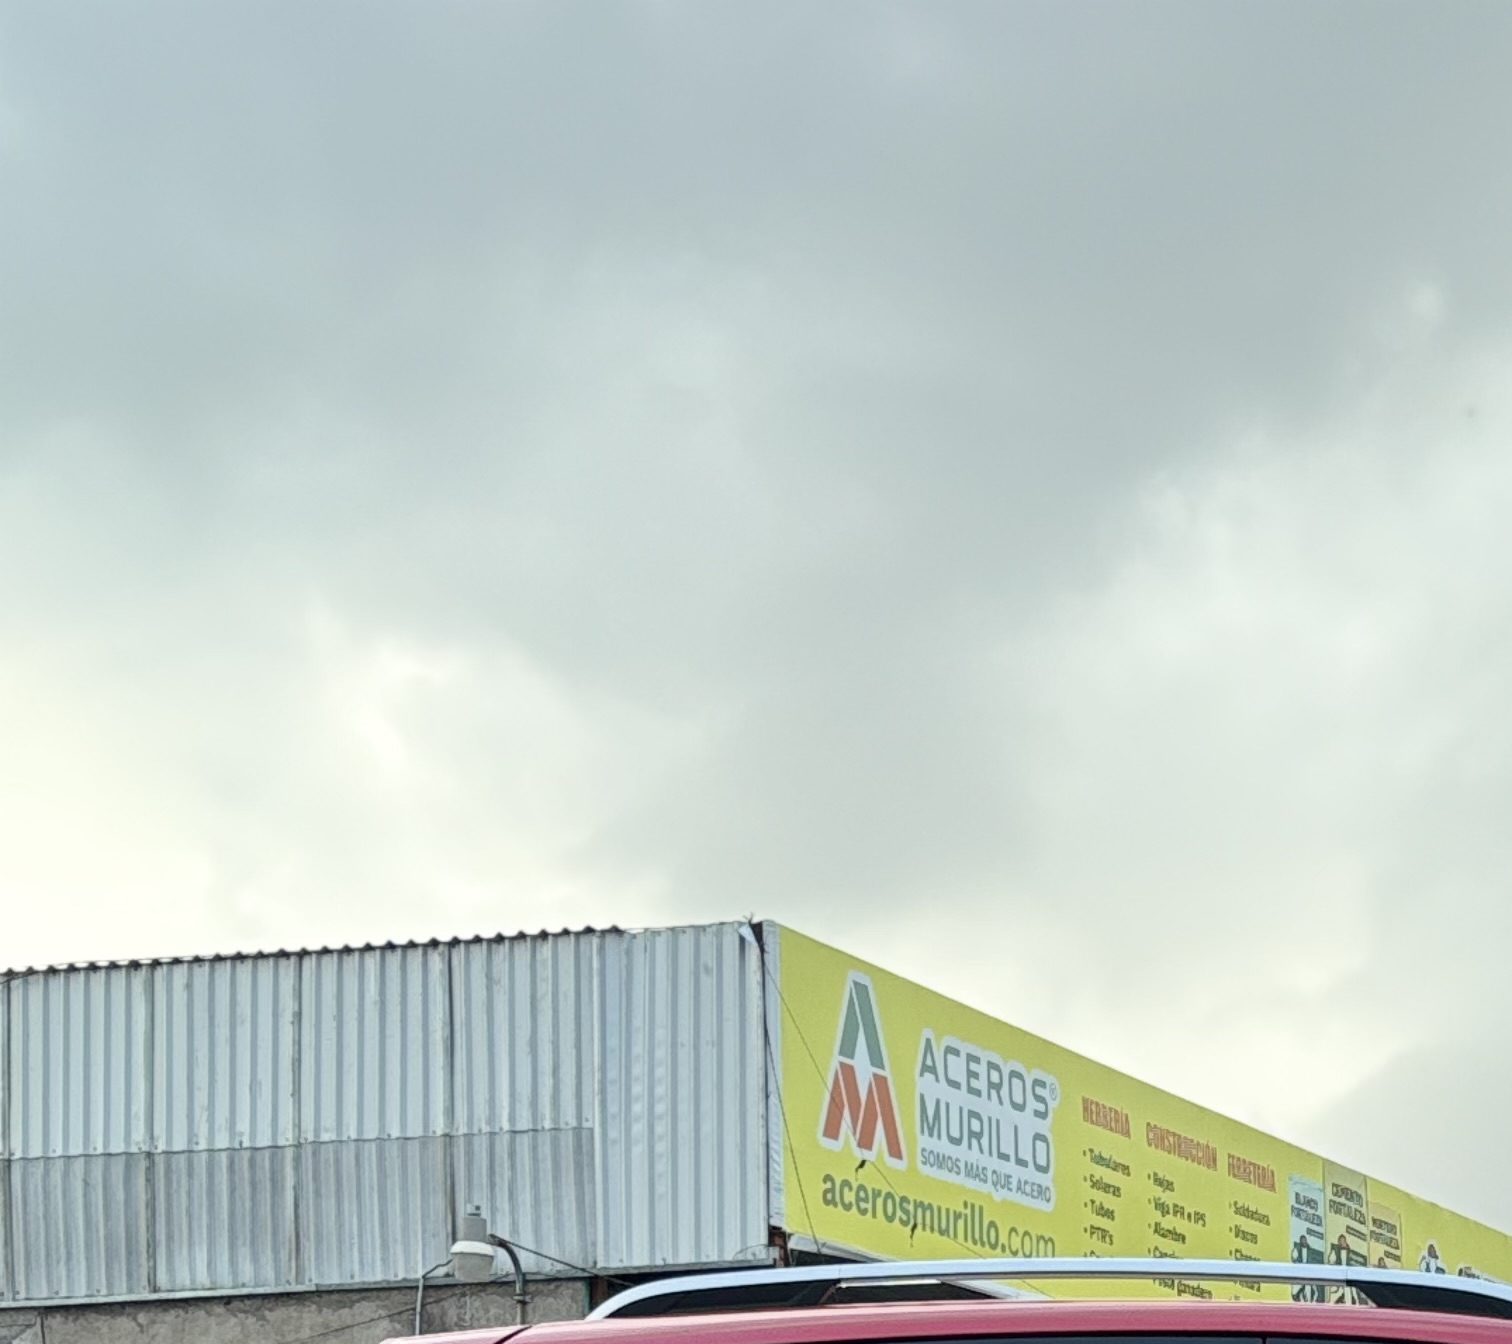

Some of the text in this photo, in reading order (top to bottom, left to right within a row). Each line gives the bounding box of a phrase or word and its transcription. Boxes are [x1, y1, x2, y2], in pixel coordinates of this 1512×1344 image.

[919, 1092, 1051, 1175] MURILLO
[920, 1147, 1051, 1203] SOMOS MÁS QUE ACERO
[822, 1173, 1056, 1258] acerosmurillo.com
